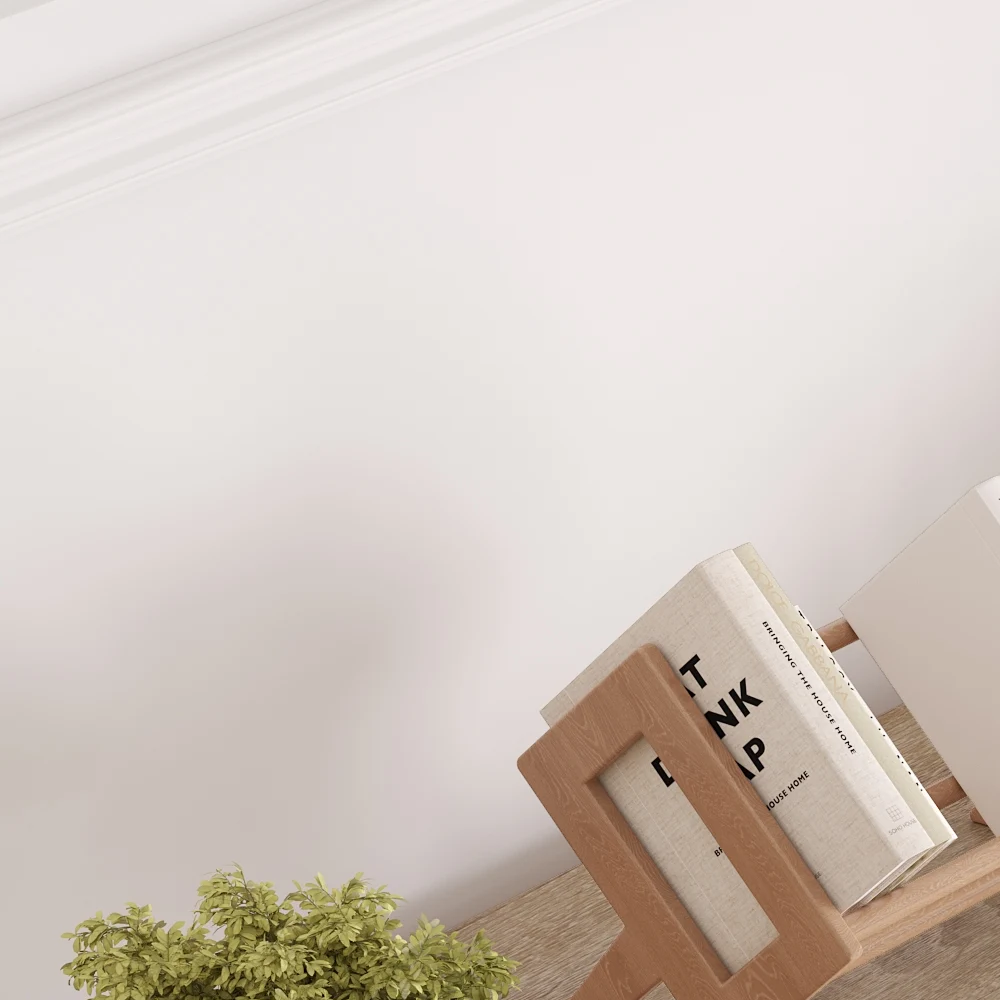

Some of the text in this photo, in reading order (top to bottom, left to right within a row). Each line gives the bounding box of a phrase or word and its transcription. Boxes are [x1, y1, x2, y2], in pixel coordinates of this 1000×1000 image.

[762, 621, 797, 668] BRINGING
[797, 671, 813, 690] THE
[811, 692, 836, 725] HOUSE
[835, 725, 857, 755] HOME
[791, 620, 848, 702] GABBANA
[788, 770, 810, 792] HOME
